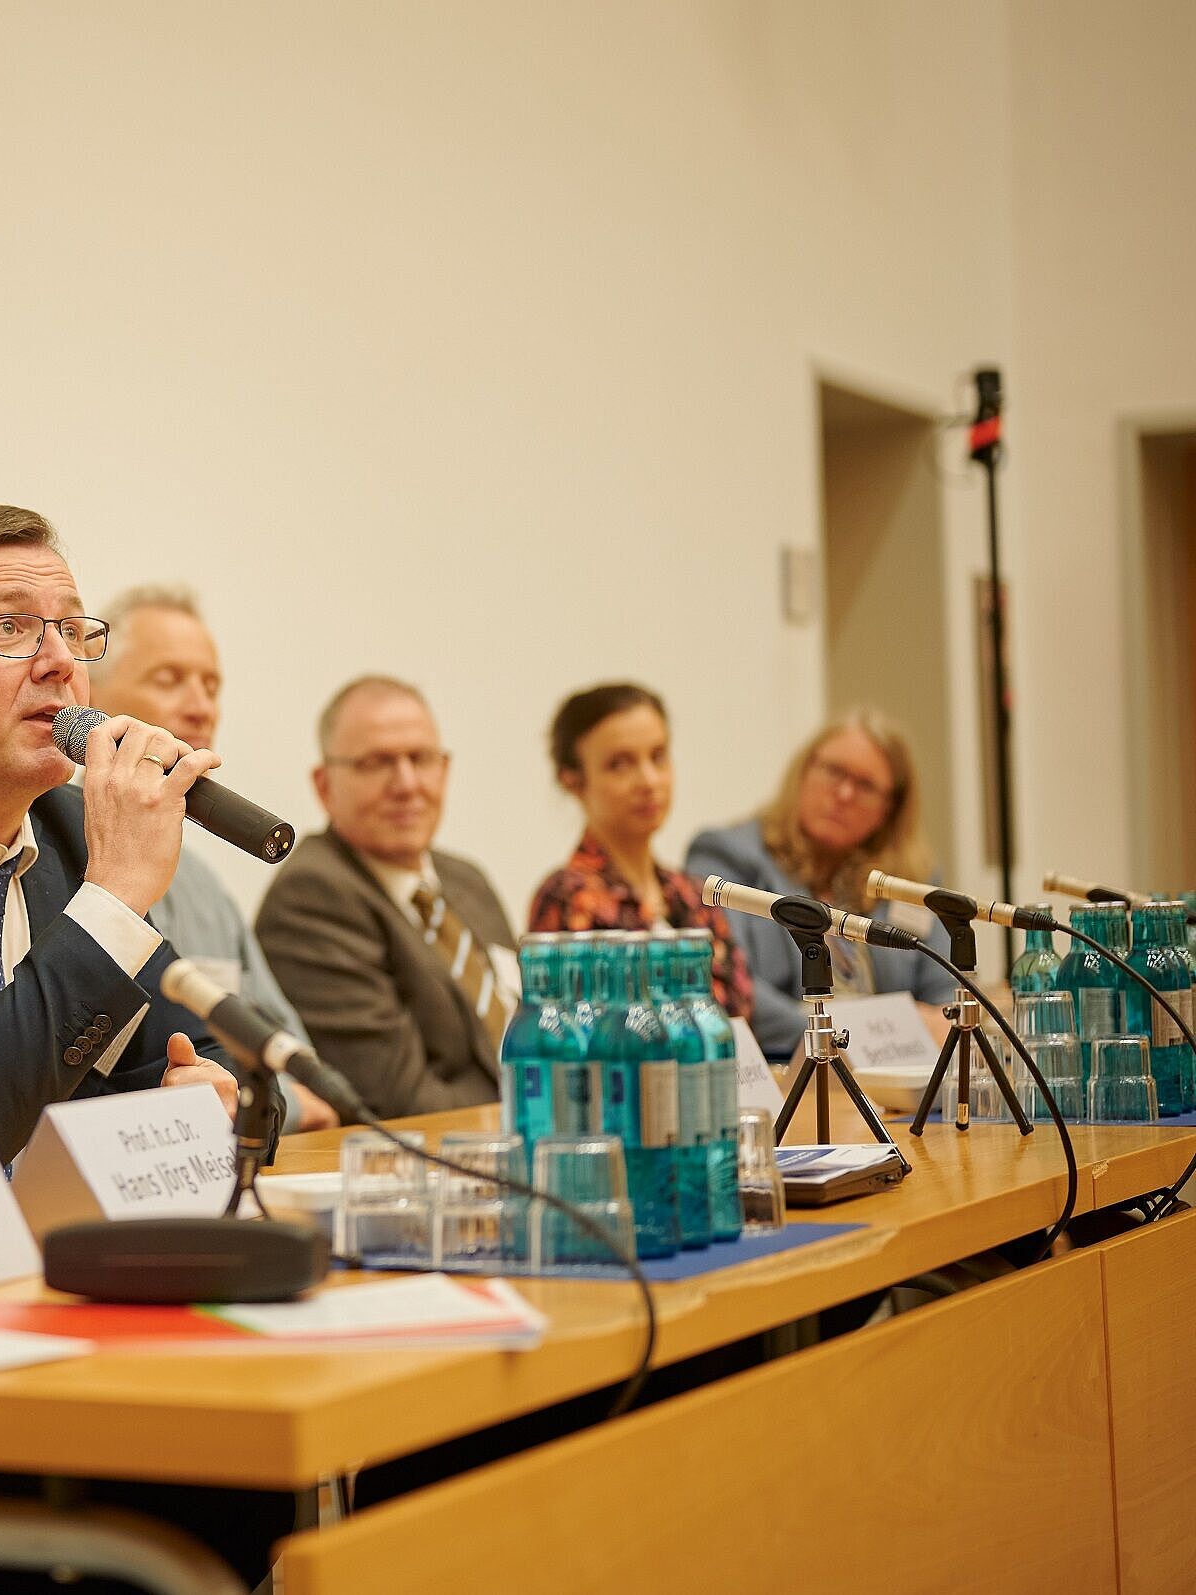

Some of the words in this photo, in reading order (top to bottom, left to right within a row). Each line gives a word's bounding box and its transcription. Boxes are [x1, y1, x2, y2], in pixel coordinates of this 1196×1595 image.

[174, 1118, 201, 1142] Dr.
[110, 1170, 162, 1203] Hans
[154, 1162, 199, 1199] Jörg
